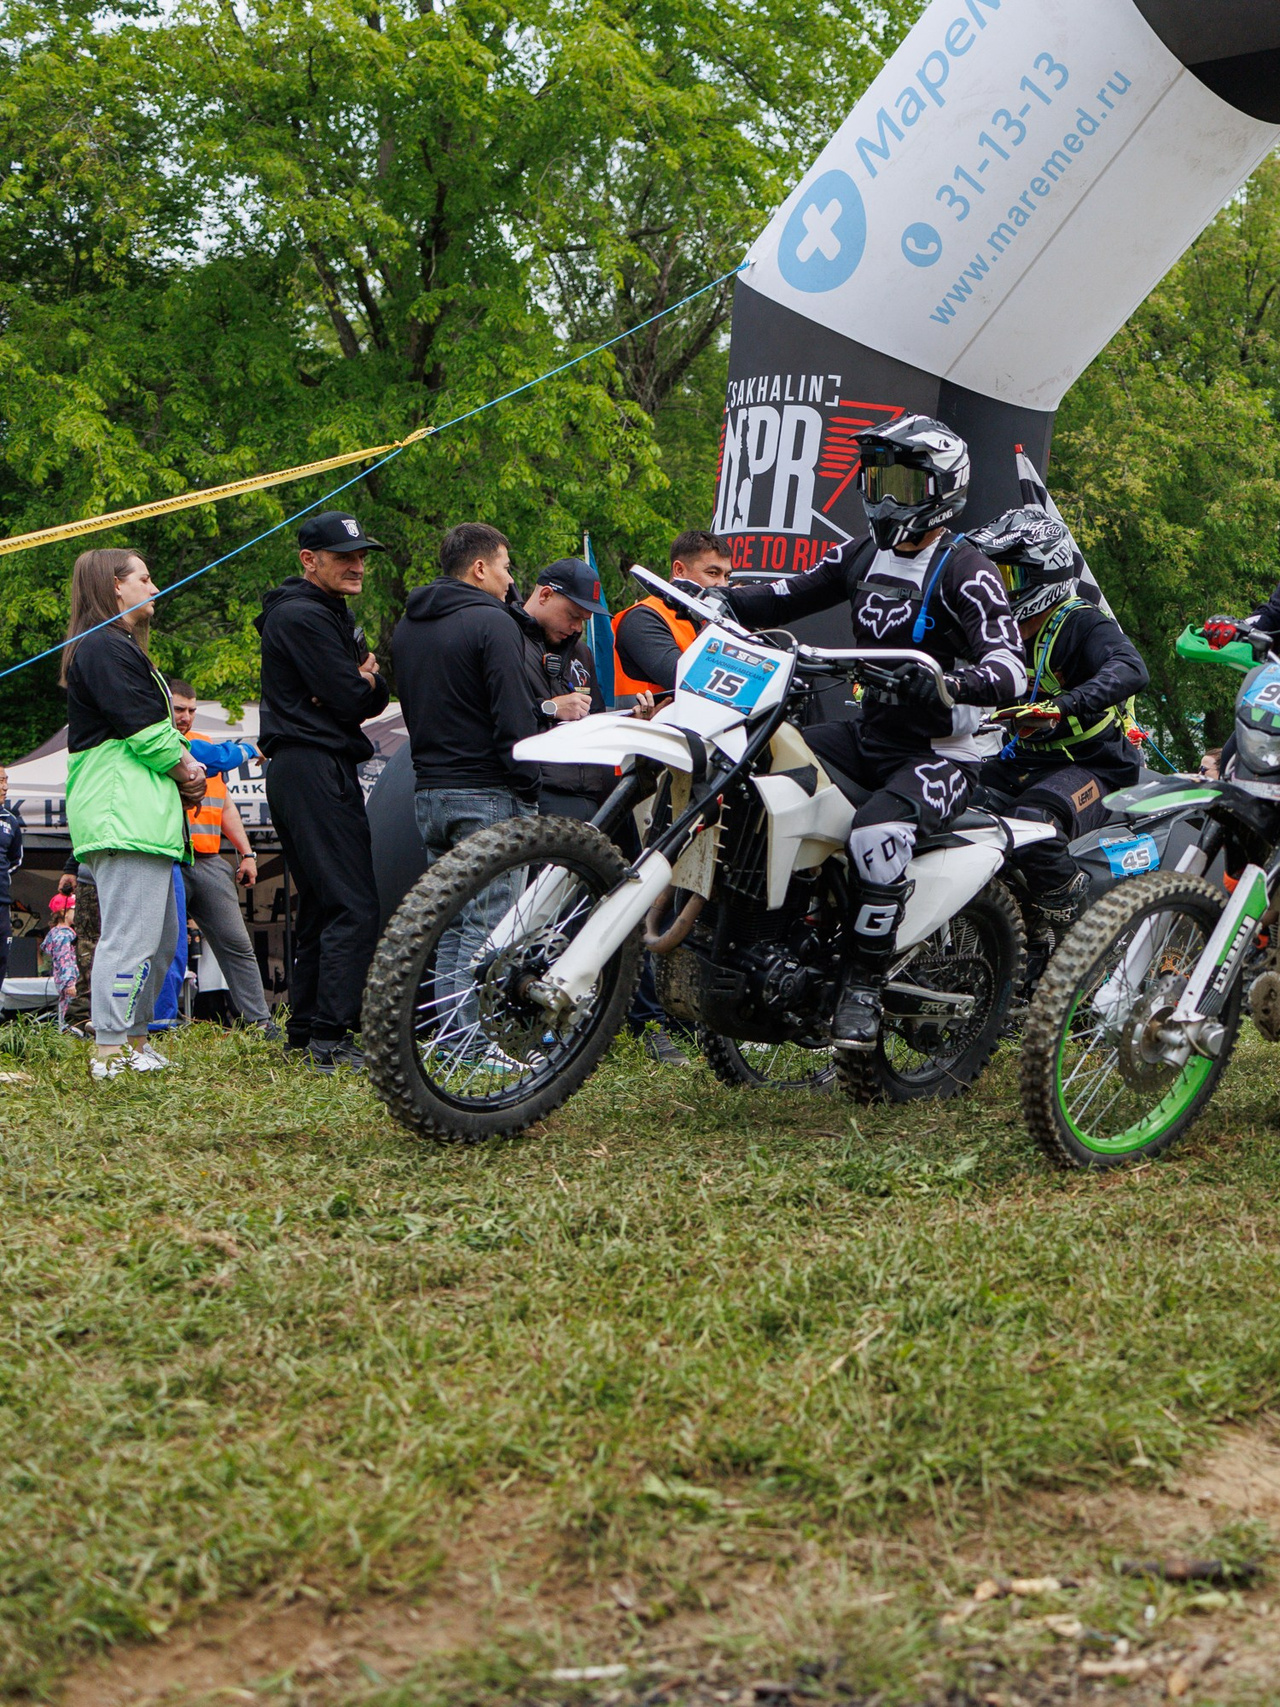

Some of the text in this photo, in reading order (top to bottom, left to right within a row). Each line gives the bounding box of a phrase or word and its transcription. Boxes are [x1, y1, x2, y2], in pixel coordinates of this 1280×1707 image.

[936, 52, 1069, 222] 31-13-13
[929, 70, 1132, 325] www.maremed.ru
[928, 508, 953, 527] RACING
[760, 536, 787, 570] TO
[705, 668, 747, 698] 15
[1122, 849, 1150, 869] 45
[854, 903, 899, 937] G
